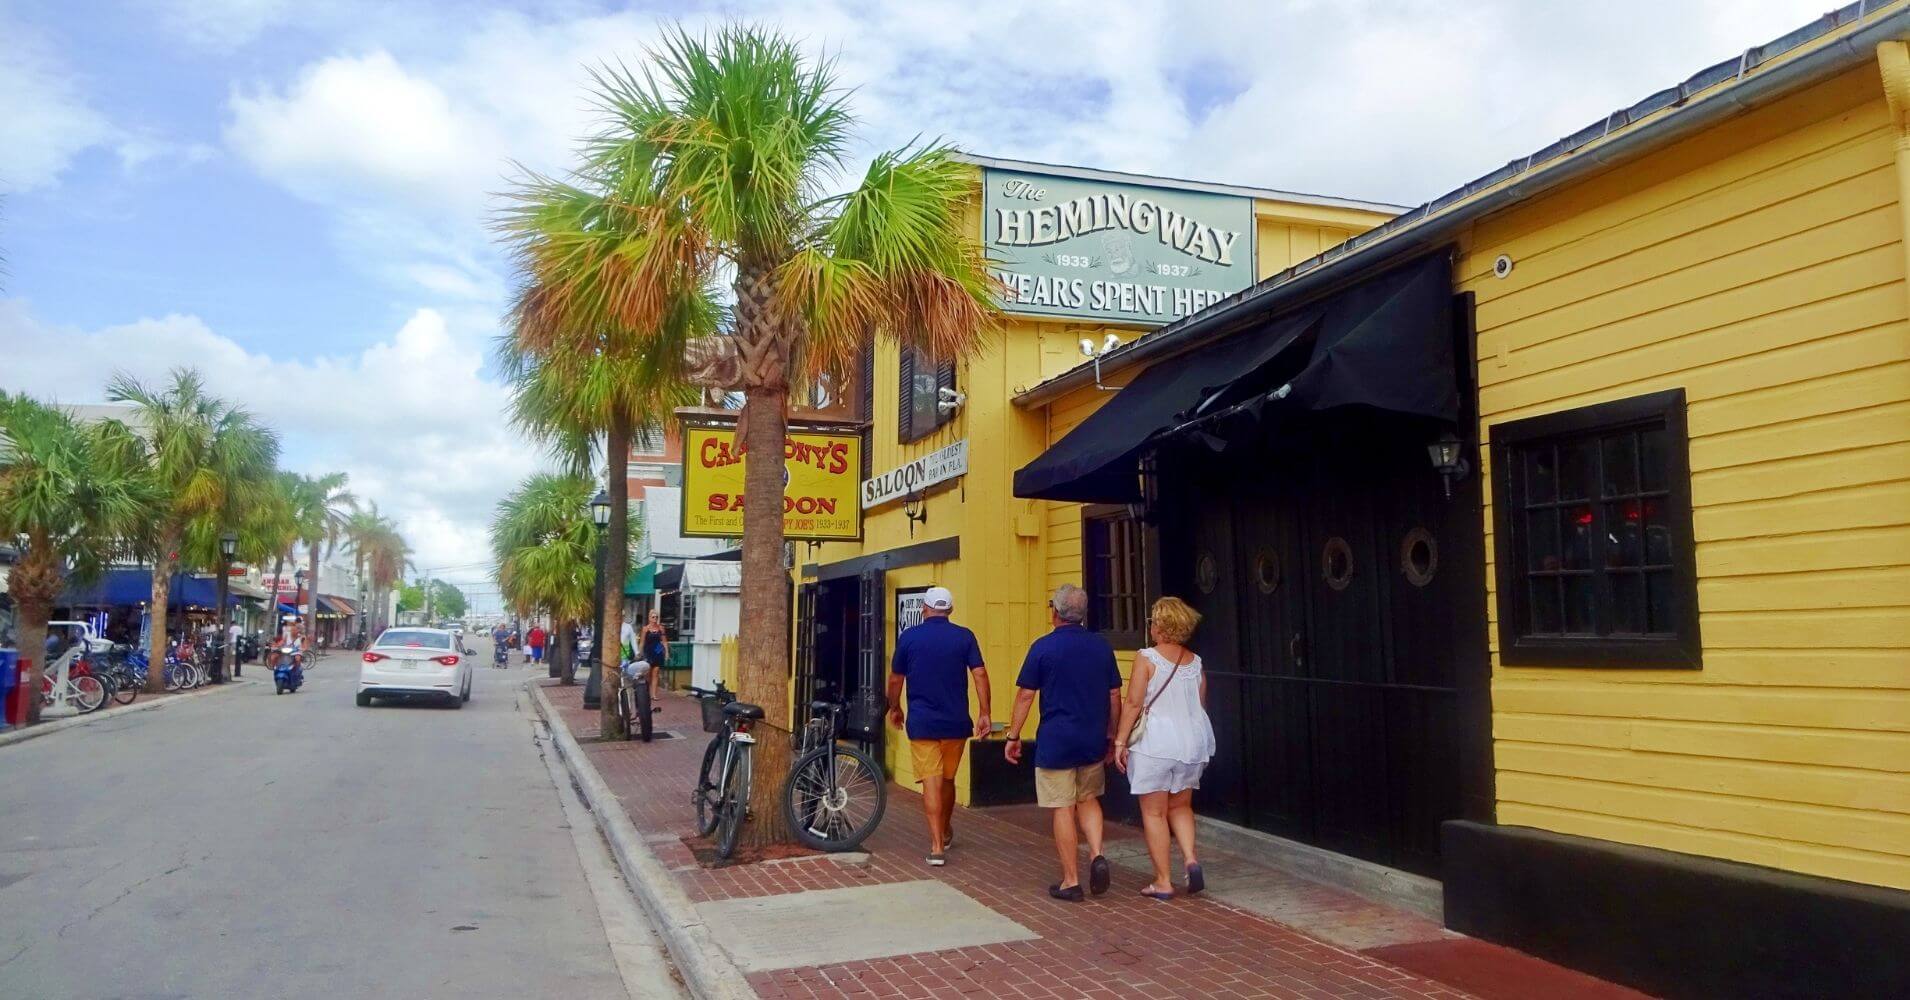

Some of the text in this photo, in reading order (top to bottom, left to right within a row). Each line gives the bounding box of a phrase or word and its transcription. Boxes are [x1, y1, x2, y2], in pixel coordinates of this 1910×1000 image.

[1002, 178, 1047, 201] The
[995, 193, 1241, 266] HEMINGWAY
[1056, 253, 1090, 268] 1933
[1157, 264, 1189, 277] 1937
[999, 272, 1233, 317] YEARS SPENT HER
[784, 438, 849, 475] ONY'S
[866, 459, 926, 502] SALOON
[695, 515, 708, 526] The
[709, 516, 725, 527] First
